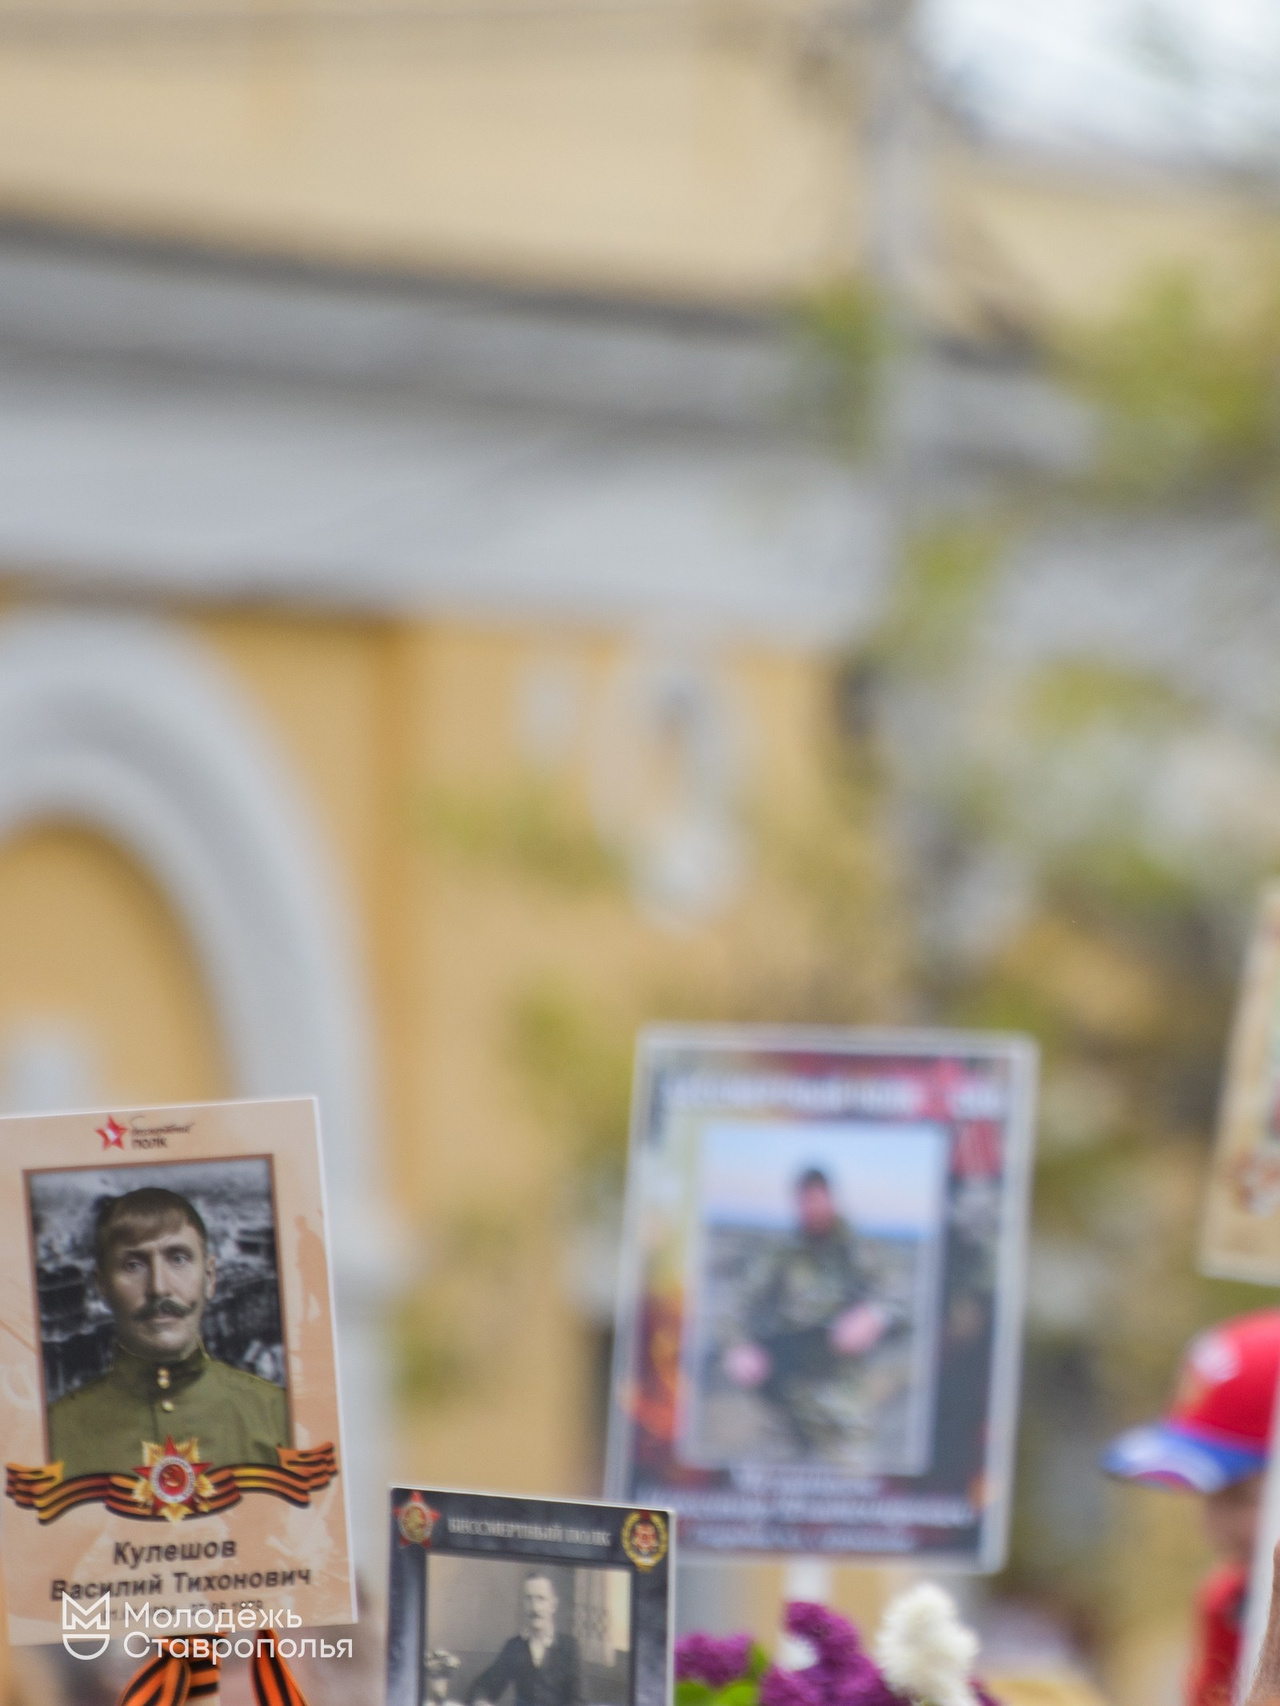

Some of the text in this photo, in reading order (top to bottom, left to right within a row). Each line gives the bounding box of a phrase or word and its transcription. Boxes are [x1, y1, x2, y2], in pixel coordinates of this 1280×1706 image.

[113, 1540, 237, 1569] Кулешов
[51, 1568, 312, 1601] Василий Тихонович
